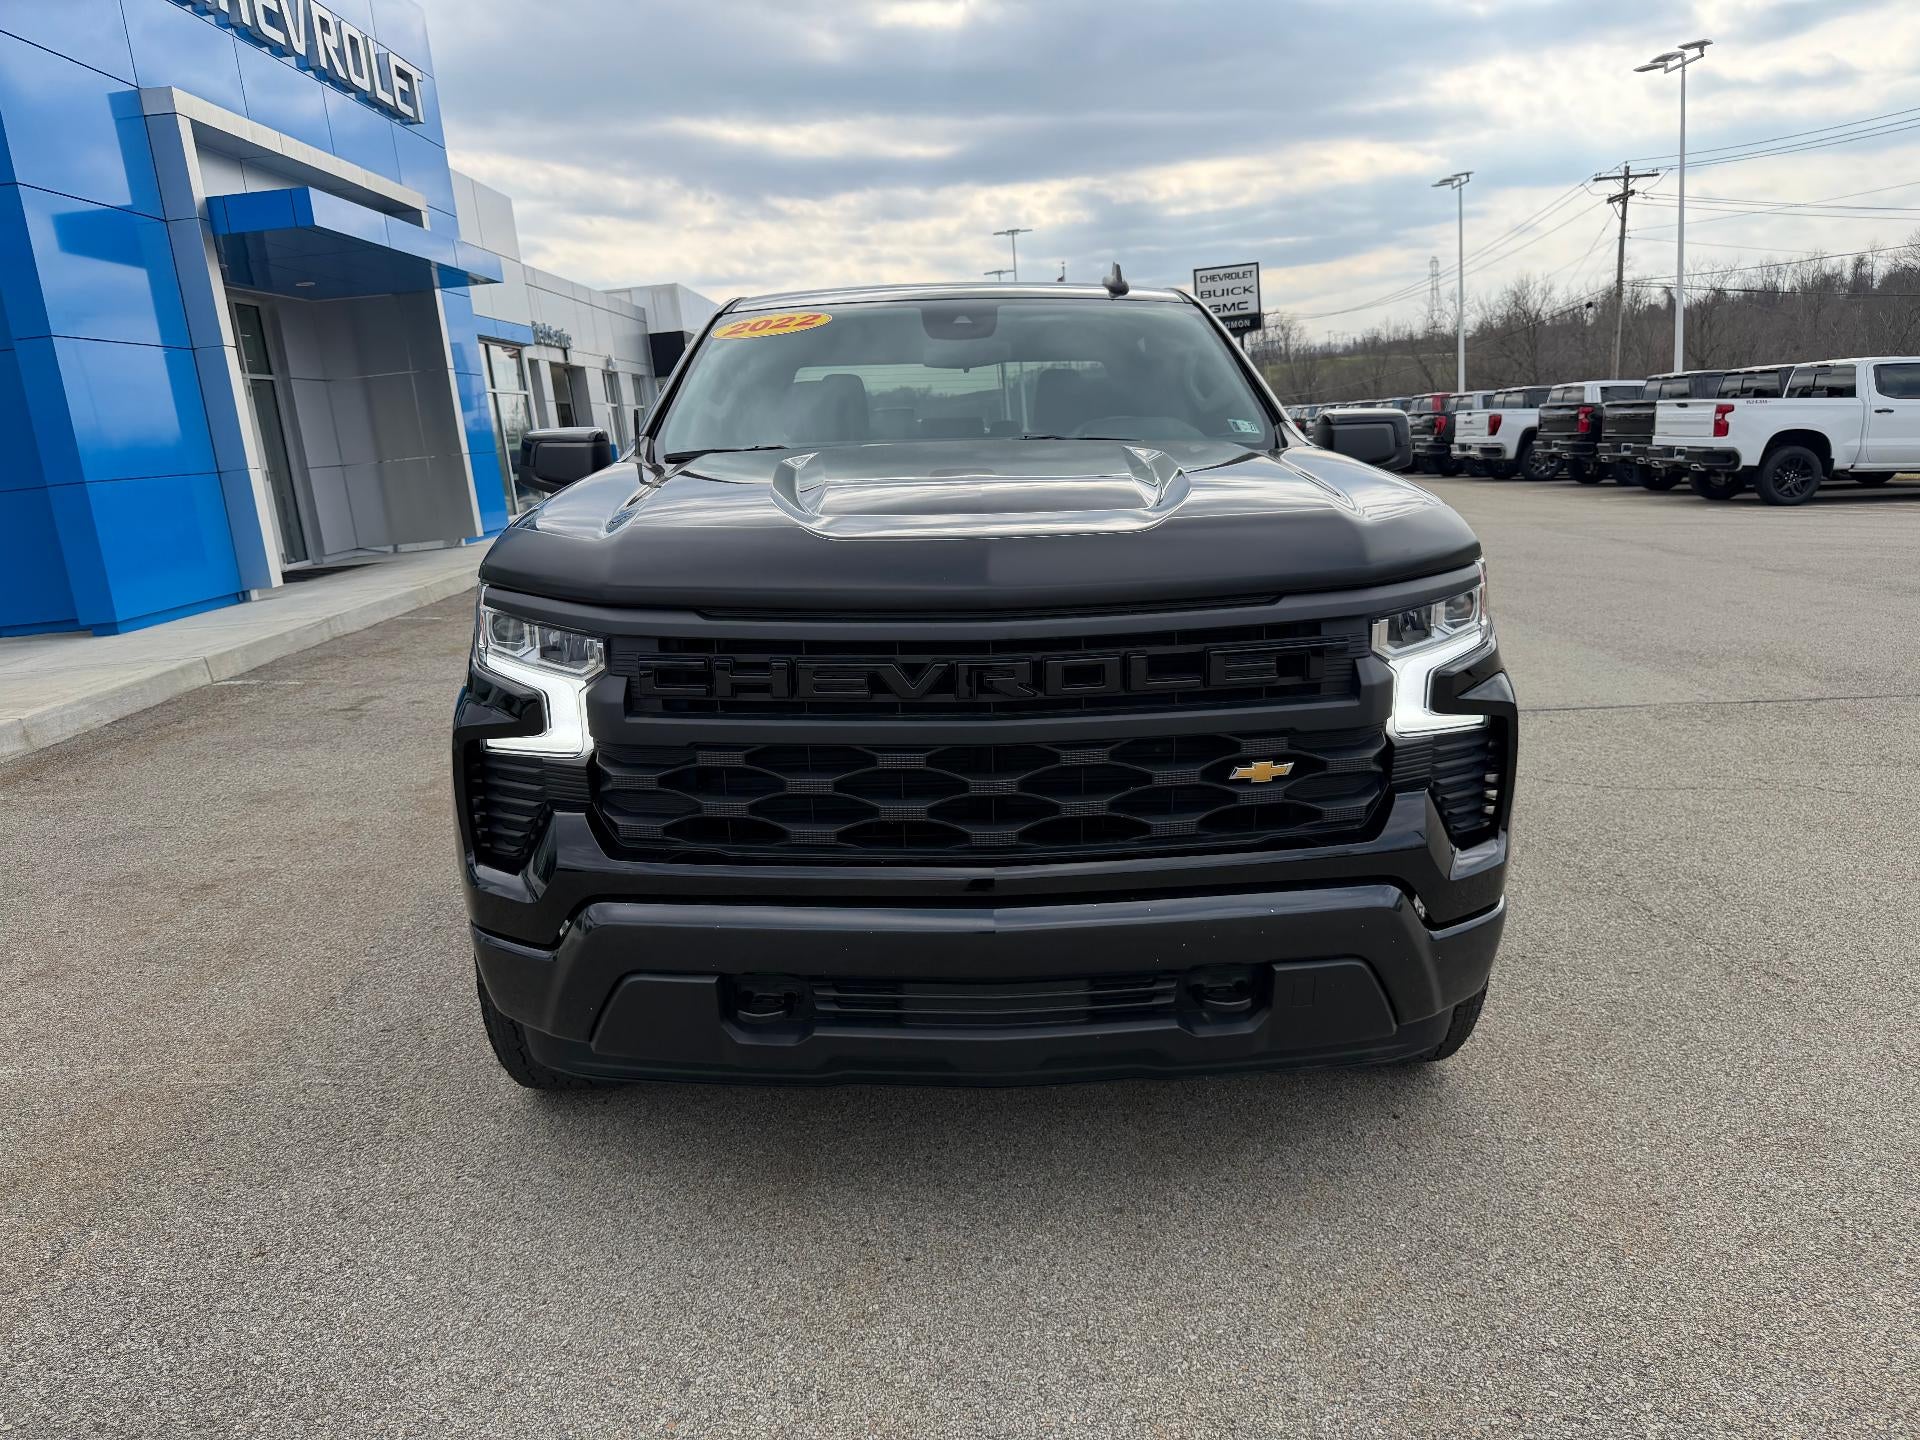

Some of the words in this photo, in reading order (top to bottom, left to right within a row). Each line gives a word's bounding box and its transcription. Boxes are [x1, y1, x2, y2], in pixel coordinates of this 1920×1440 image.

[204, 0, 424, 124] EVROLET
[1200, 270, 1254, 284] CHEVROLET
[1200, 285, 1256, 299] BUICK
[1208, 301, 1249, 313] GMC
[722, 314, 822, 337] 2022
[637, 637, 1349, 700] CHEVROLET
